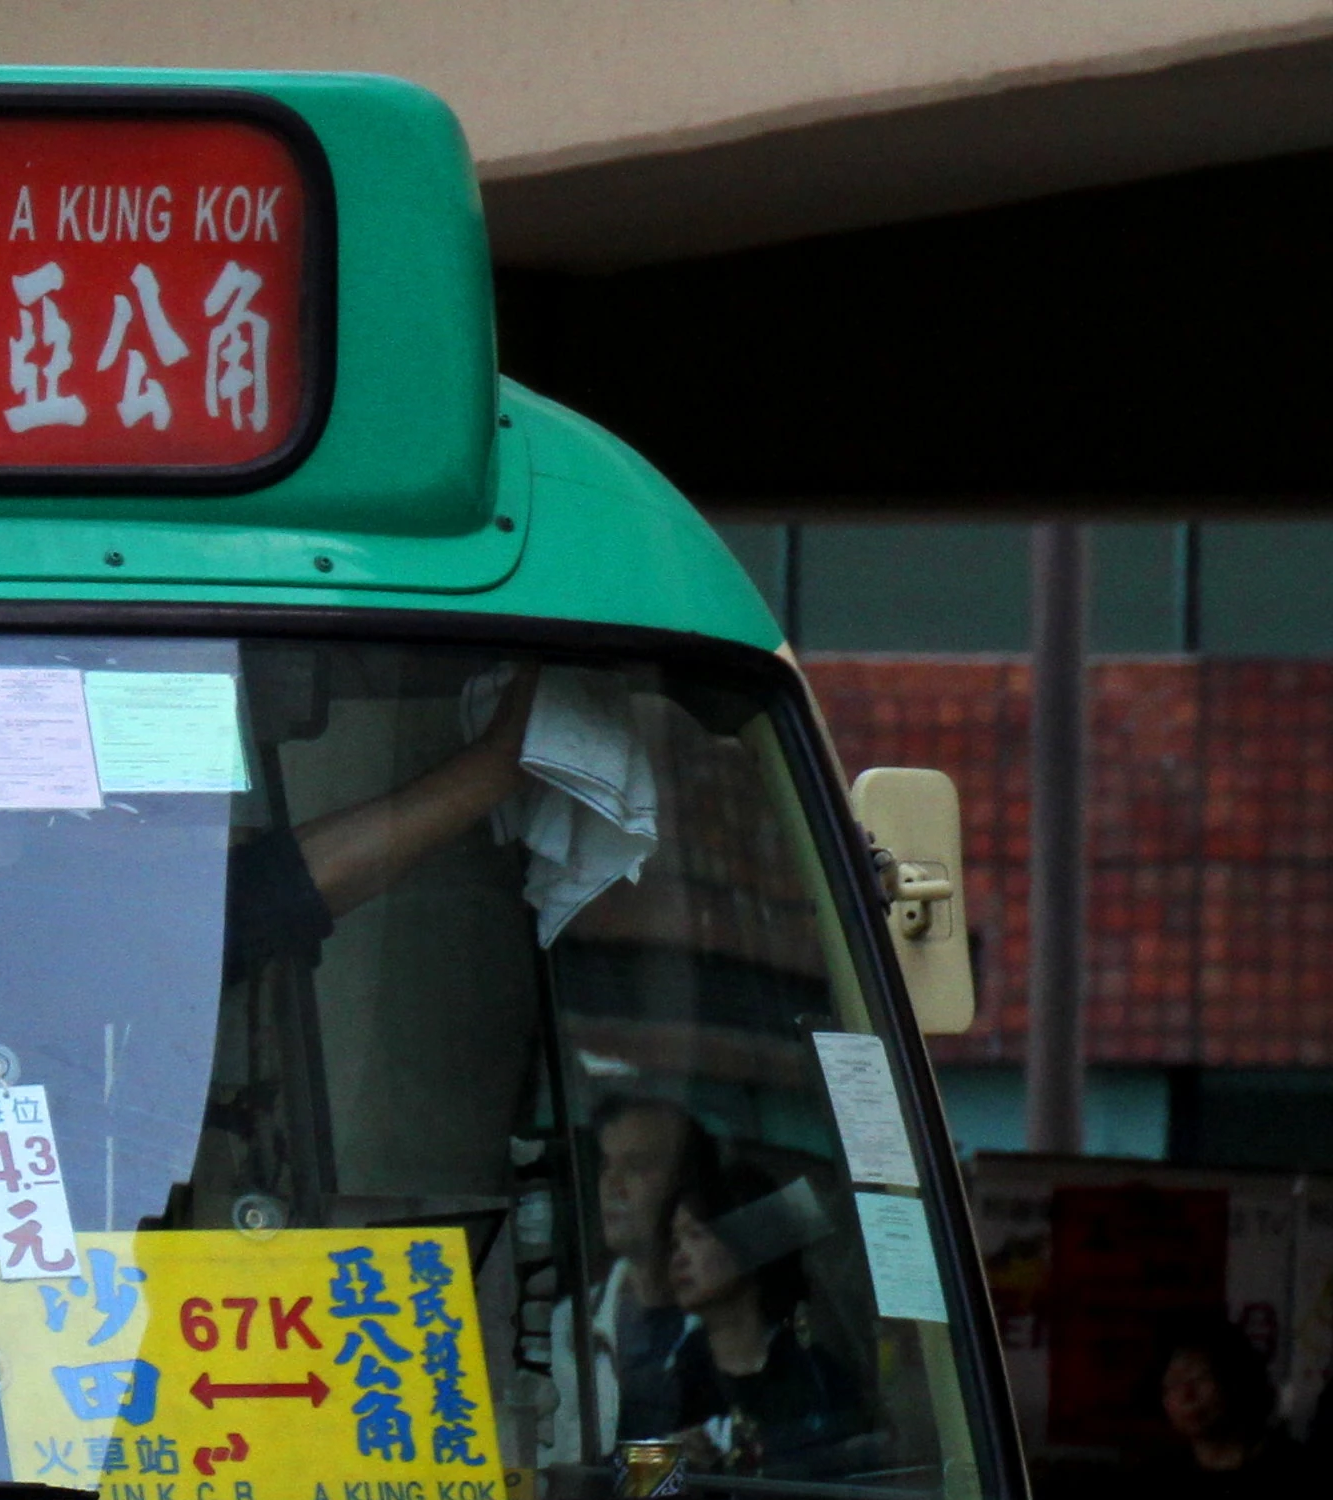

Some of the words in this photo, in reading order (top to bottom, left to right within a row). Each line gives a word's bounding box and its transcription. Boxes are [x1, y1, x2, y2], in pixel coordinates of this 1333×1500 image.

[9, 186, 36, 241] A
[58, 186, 172, 243] KUNG
[194, 186, 282, 243] KOK
[3, 260, 271, 433] 亞公角
[3, 1199, 76, 1272] 元
[37, 1248, 161, 1427] 沙田
[179, 1297, 323, 1351] 67K
[327, 1246, 417, 1462] 亞公角
[35, 1434, 181, 1478] 火車站
